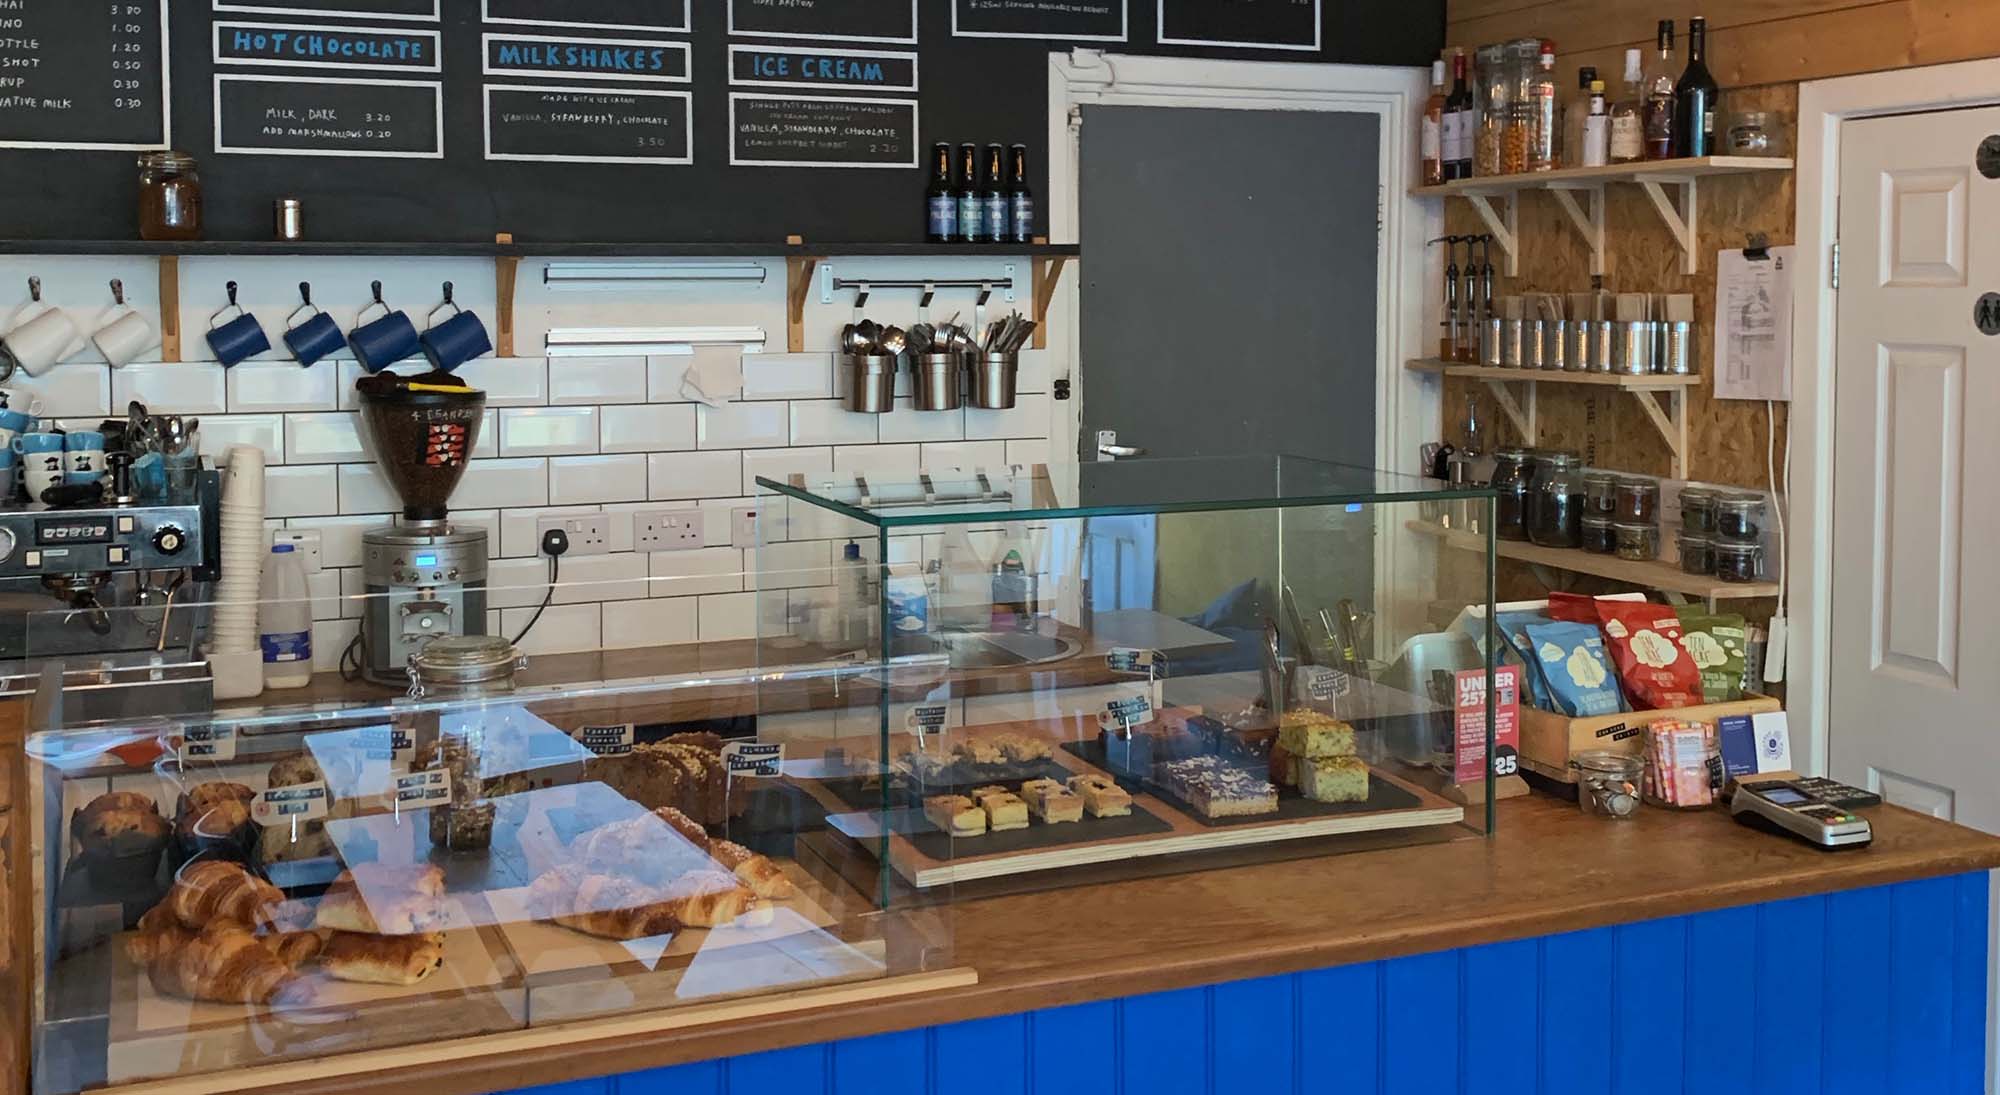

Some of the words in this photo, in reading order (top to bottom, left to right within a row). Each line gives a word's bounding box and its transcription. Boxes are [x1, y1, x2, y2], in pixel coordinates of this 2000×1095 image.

[234, 31, 288, 53] HOT
[294, 35, 421, 59] CHOCOLATE
[3, 57, 40, 67] SHOT
[754, 55, 789, 76] ICE
[802, 58, 884, 81] CREAM
[43, 98, 72, 109] MILK
[309, 109, 336, 120] DARK
[263, 126, 283, 135] ADD
[288, 128, 362, 138] MARSHMALLOWS
[1495, 755, 1517, 774] 25
